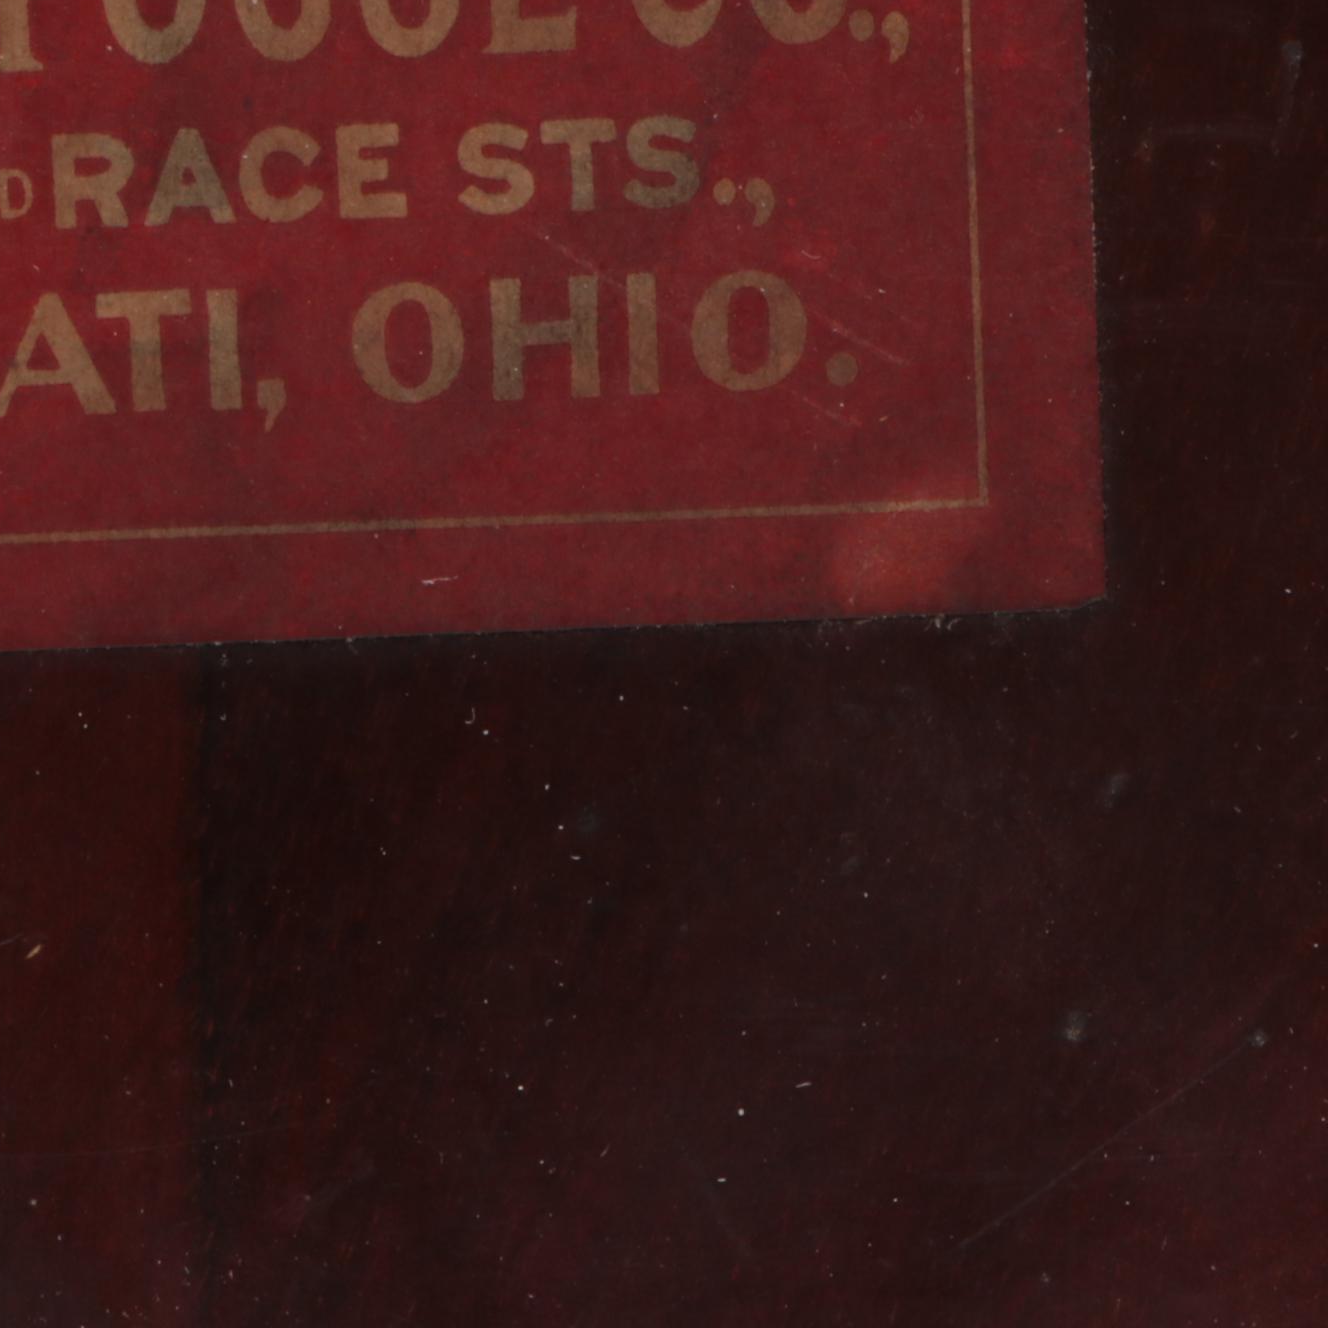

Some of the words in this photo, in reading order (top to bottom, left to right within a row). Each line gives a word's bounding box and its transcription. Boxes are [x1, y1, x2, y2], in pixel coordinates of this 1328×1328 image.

[50, 121, 410, 232] RACE
[455, 113, 778, 229] STS.,
[350, 269, 861, 405] OHIO.
